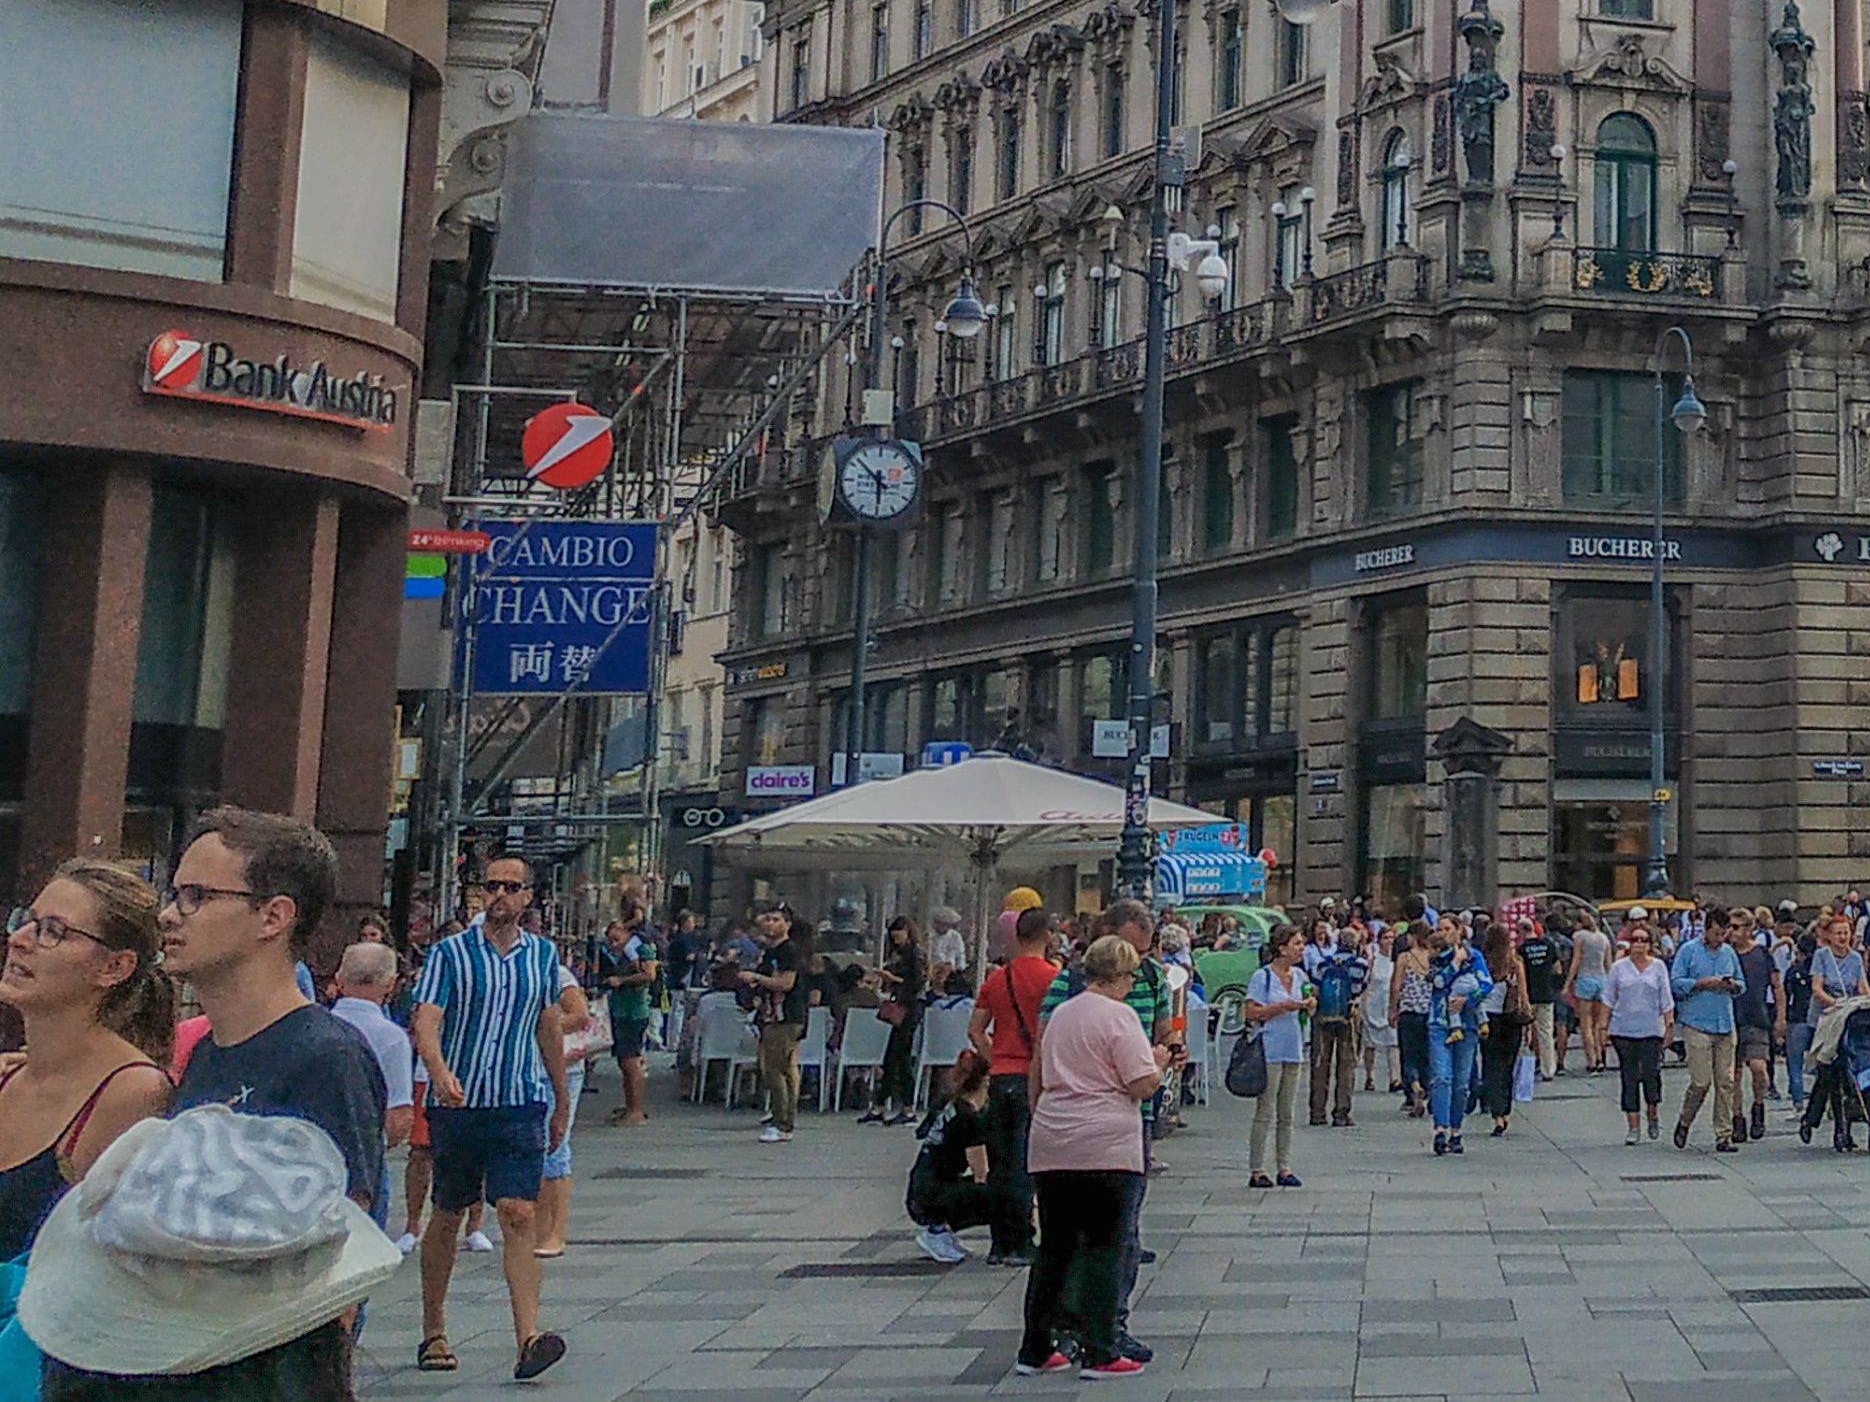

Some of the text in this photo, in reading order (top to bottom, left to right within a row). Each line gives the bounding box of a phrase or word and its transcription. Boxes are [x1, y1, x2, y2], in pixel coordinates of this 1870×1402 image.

[205, 341, 397, 425] Bank Austria
[488, 536, 634, 567] CAMBIO
[1355, 544, 1413, 571] BUCHERER
[462, 585, 652, 625] CHANGE
[509, 641, 597, 684] 両替
[751, 772, 810, 788] claire's
